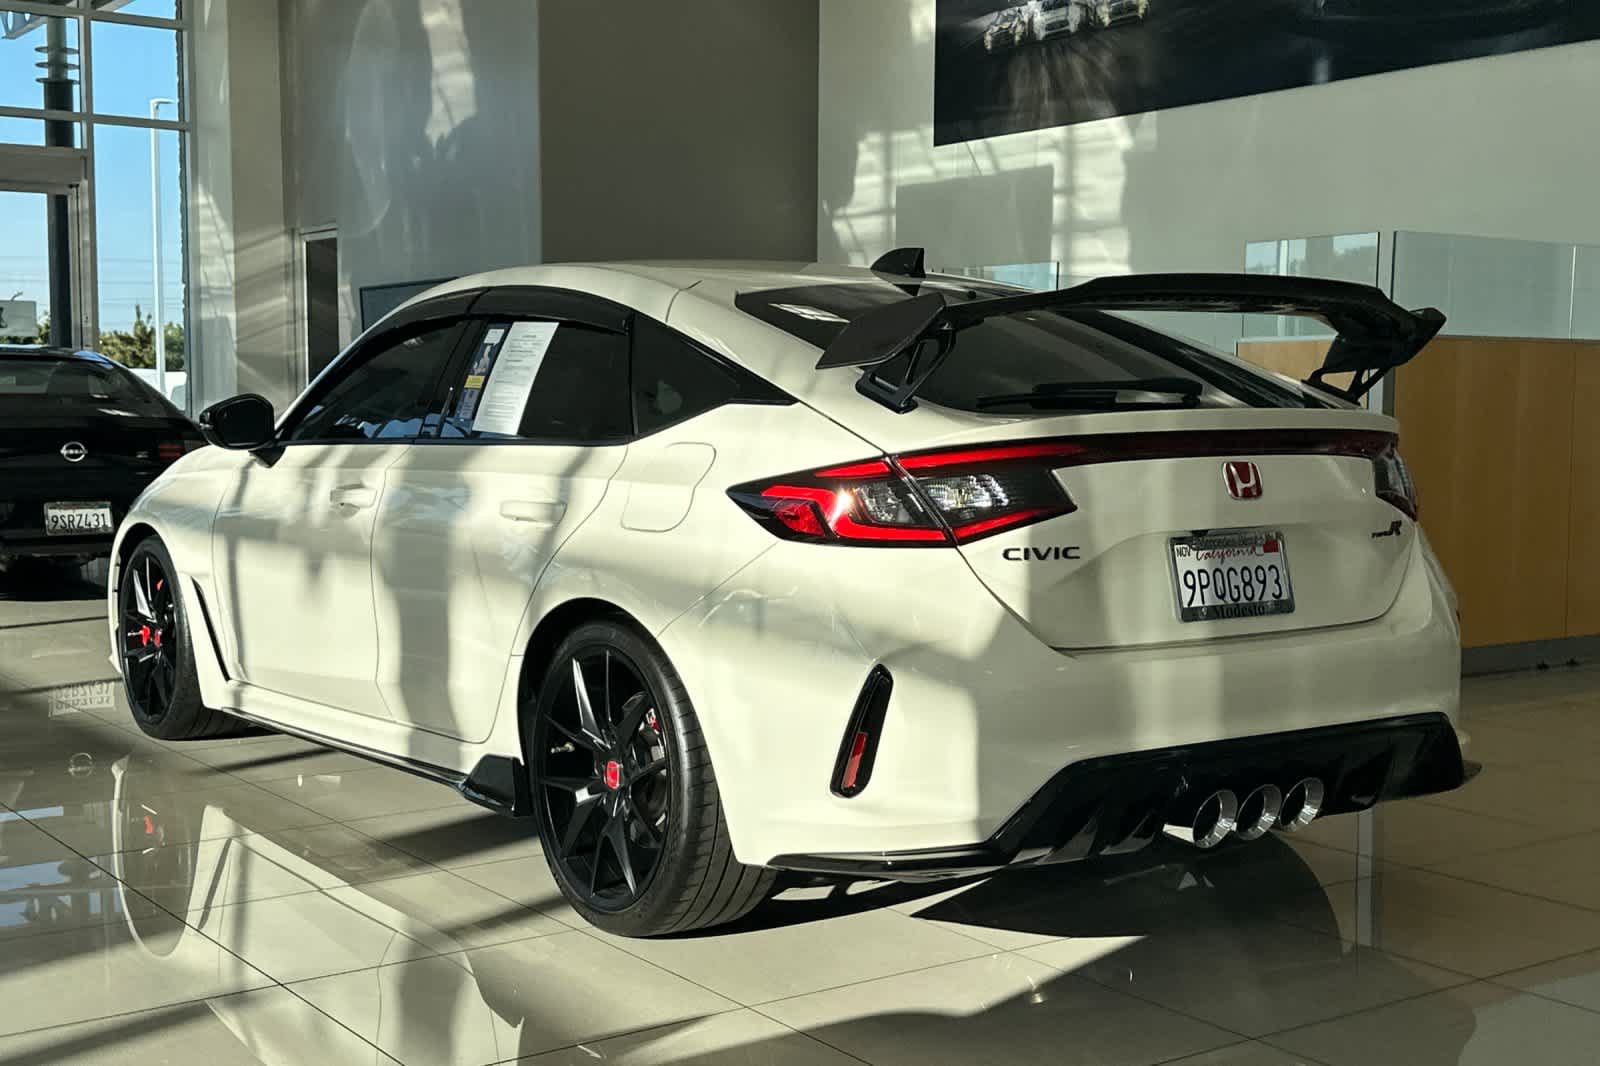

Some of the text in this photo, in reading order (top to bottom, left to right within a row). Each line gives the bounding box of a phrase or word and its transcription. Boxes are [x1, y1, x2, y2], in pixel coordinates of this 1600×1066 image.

[51, 512, 109, 529] 9SRZ431
[1002, 546, 1081, 561] CIVIC
[1183, 564, 1283, 607] 9PQG893
